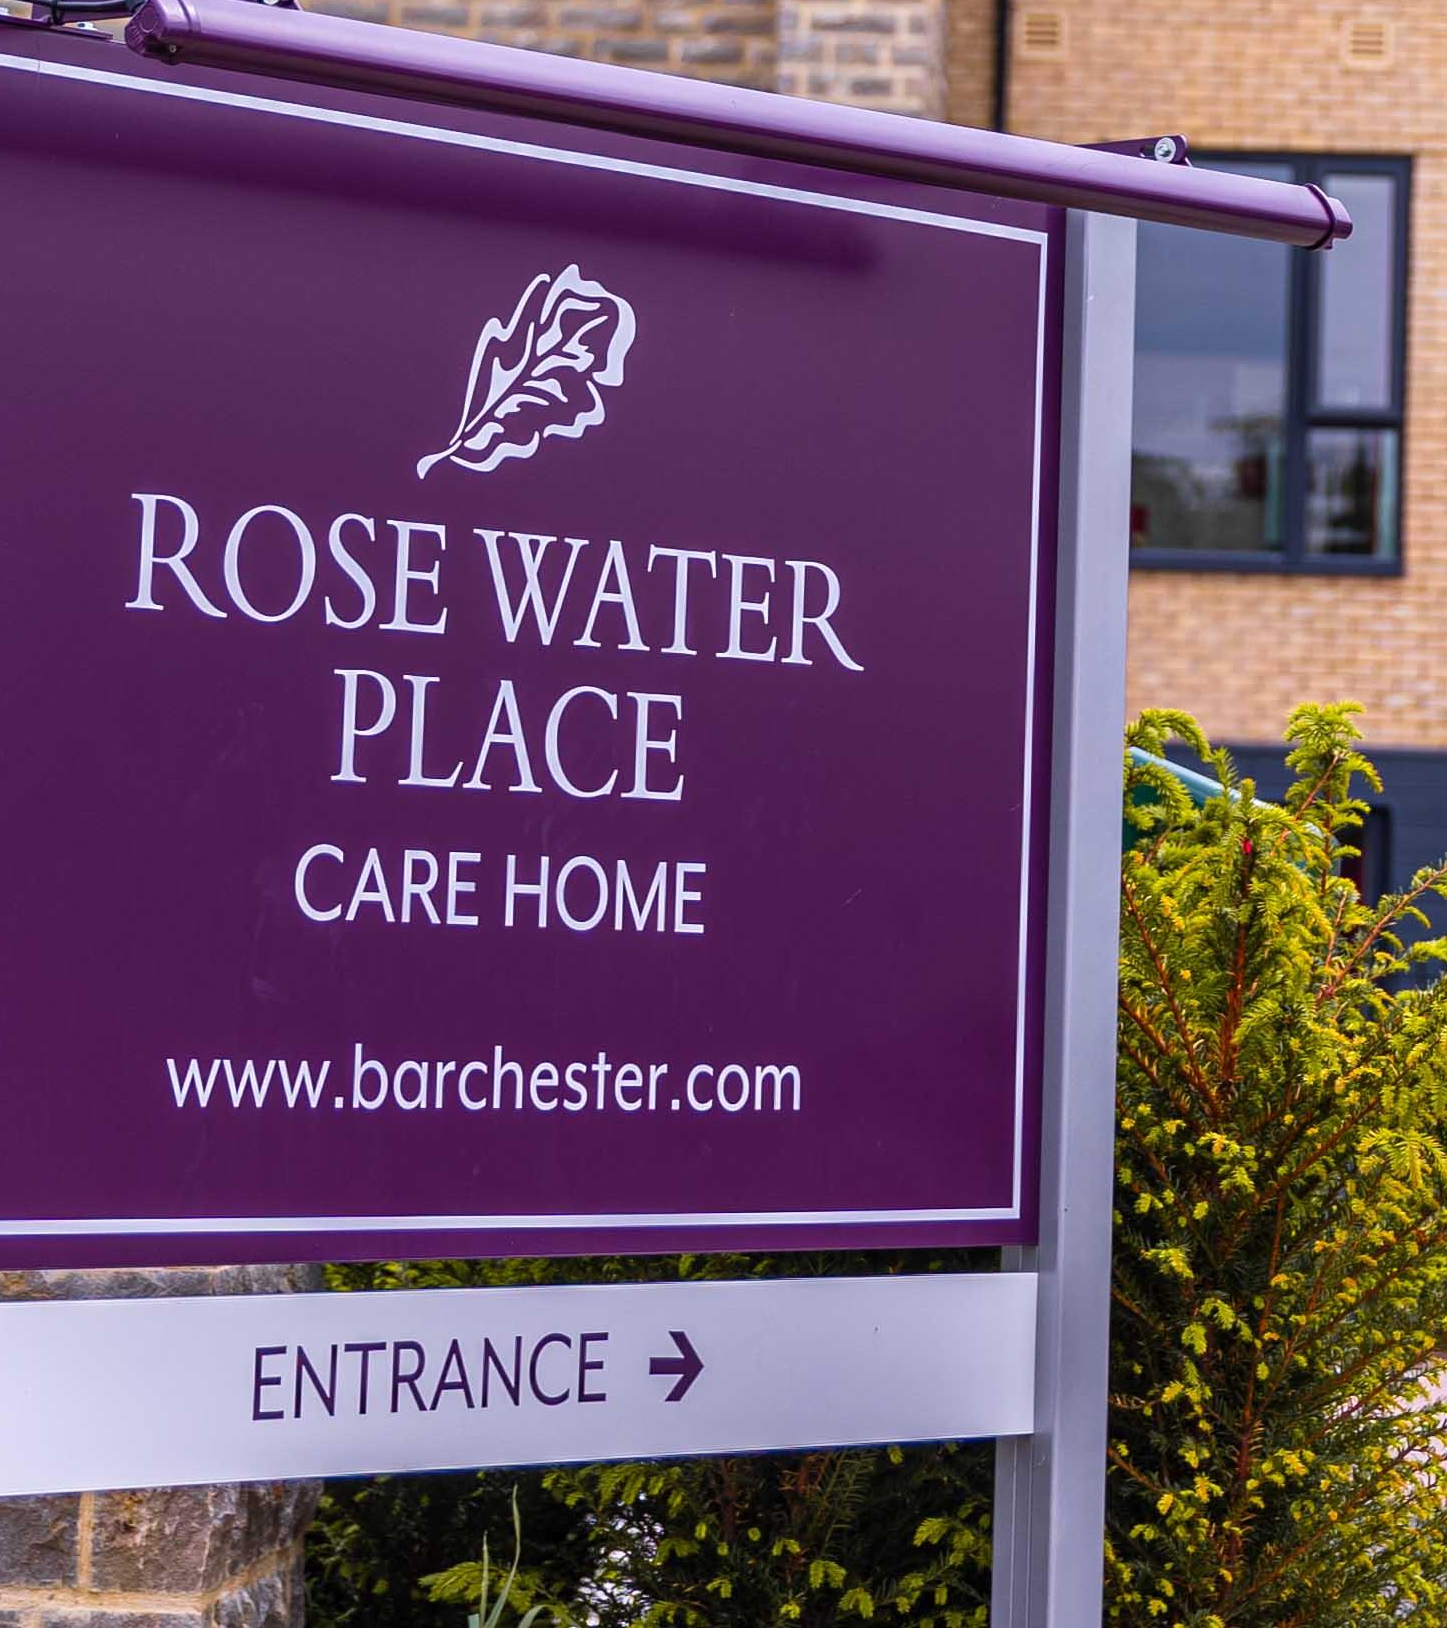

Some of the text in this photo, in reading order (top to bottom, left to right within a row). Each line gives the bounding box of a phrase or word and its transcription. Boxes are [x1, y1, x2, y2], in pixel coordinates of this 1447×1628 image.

[123, 492, 866, 673] ROSE WATER
[329, 667, 685, 802] PLACE
[293, 842, 708, 935] CARE HOME
[165, 1042, 802, 1113] www.barchester.com
[251, 1330, 610, 1422] ENTRANCE
